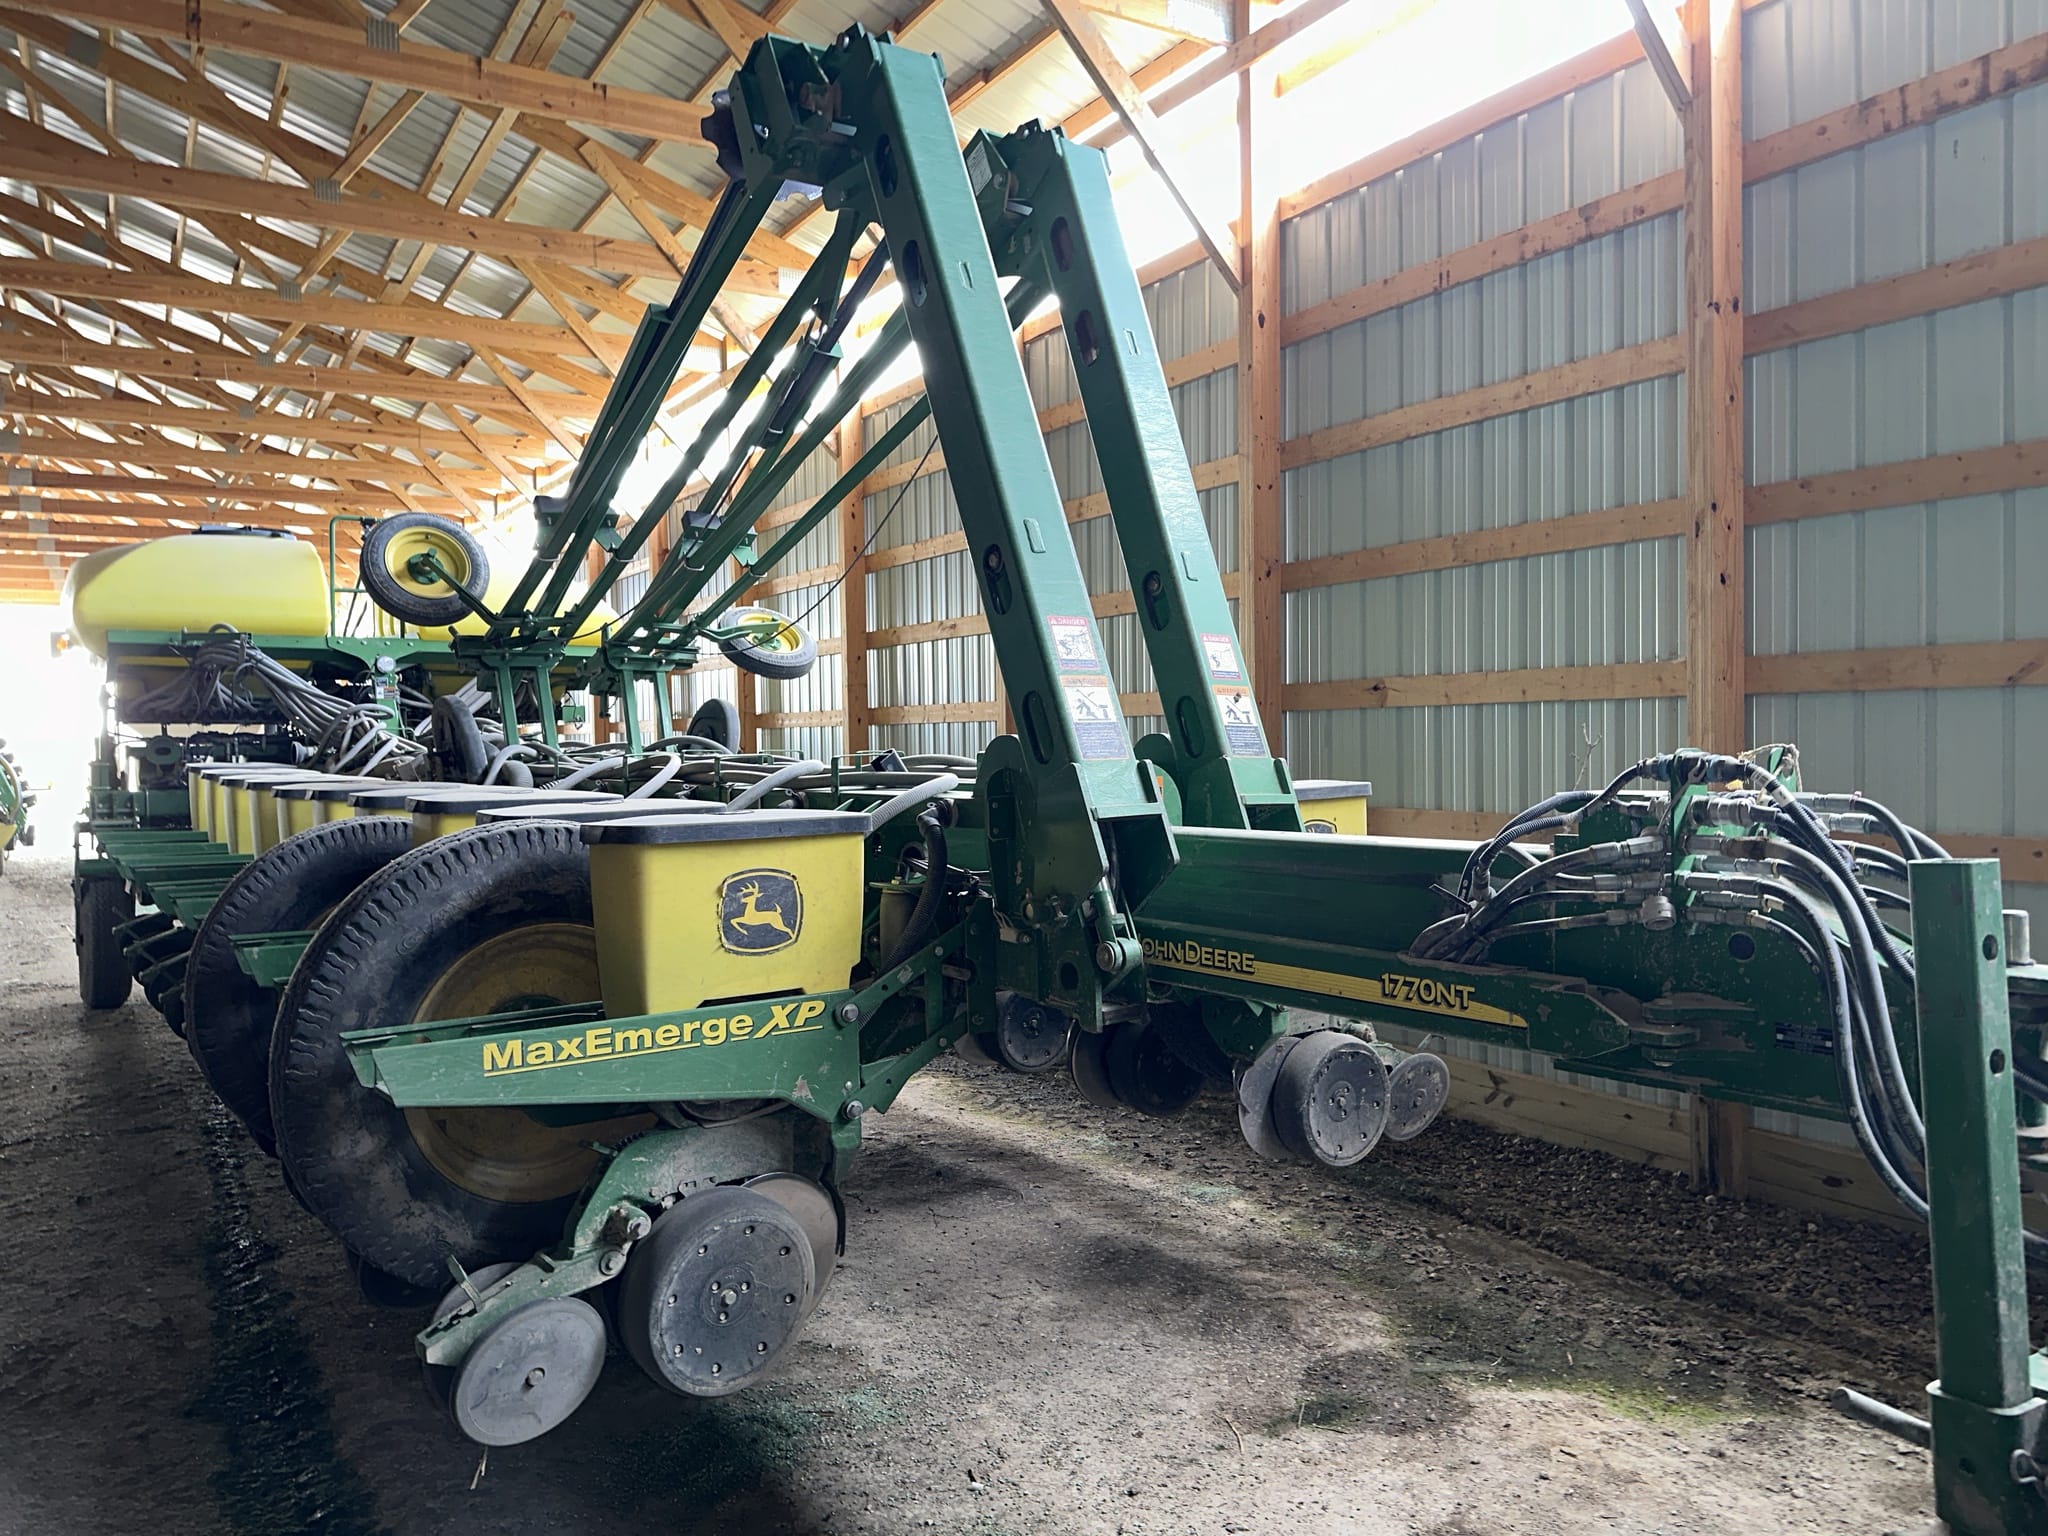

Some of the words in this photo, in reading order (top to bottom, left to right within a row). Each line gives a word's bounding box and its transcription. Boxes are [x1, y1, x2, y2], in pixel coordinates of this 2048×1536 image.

[1140, 937, 1183, 962] OHN
[1185, 940, 1255, 973] DEERE
[1382, 973, 1475, 1008] 1770NT
[483, 1013, 753, 1071] MaxEmerge
[753, 1000, 826, 1039] XP
